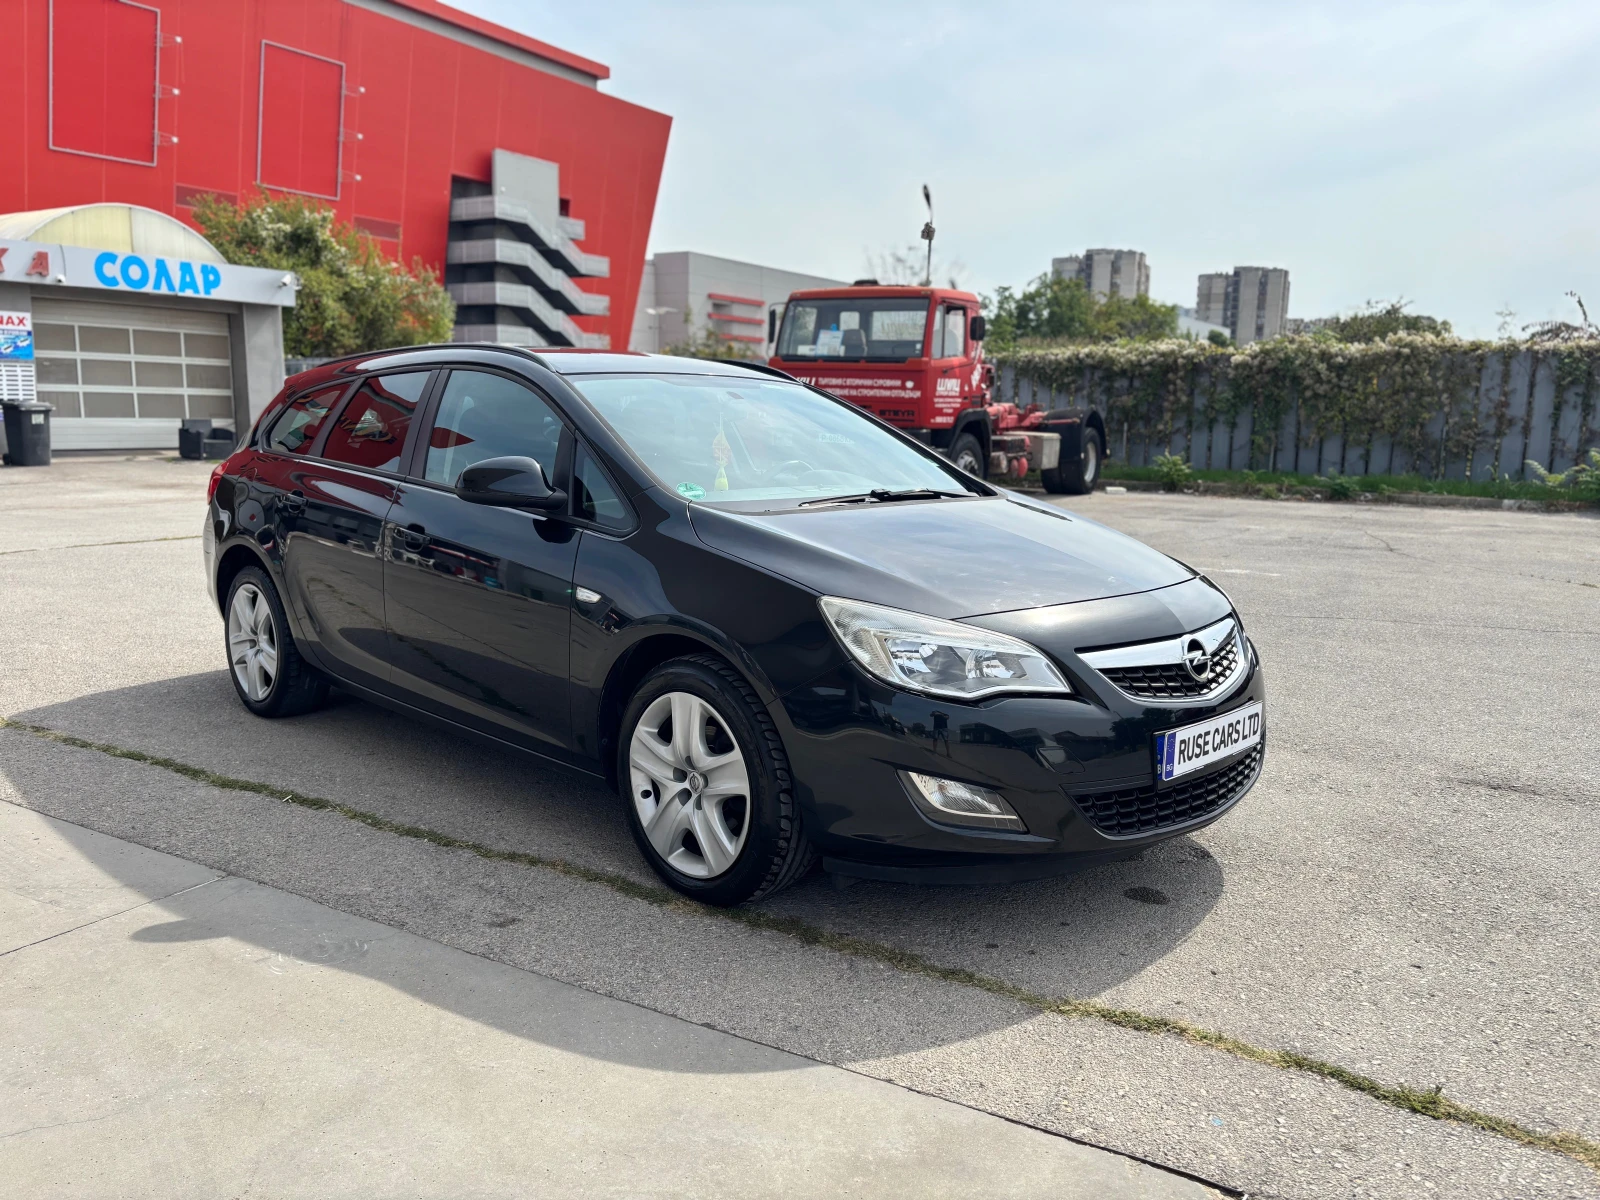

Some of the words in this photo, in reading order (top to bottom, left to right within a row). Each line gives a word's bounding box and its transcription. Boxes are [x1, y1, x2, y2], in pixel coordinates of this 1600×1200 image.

[94, 251, 221, 295] СОЛАР
[1177, 730, 1211, 765] RUSE
[1212, 719, 1241, 753] CARS
[1241, 712, 1260, 740] LTD
[1166, 763, 1173, 772] BG
